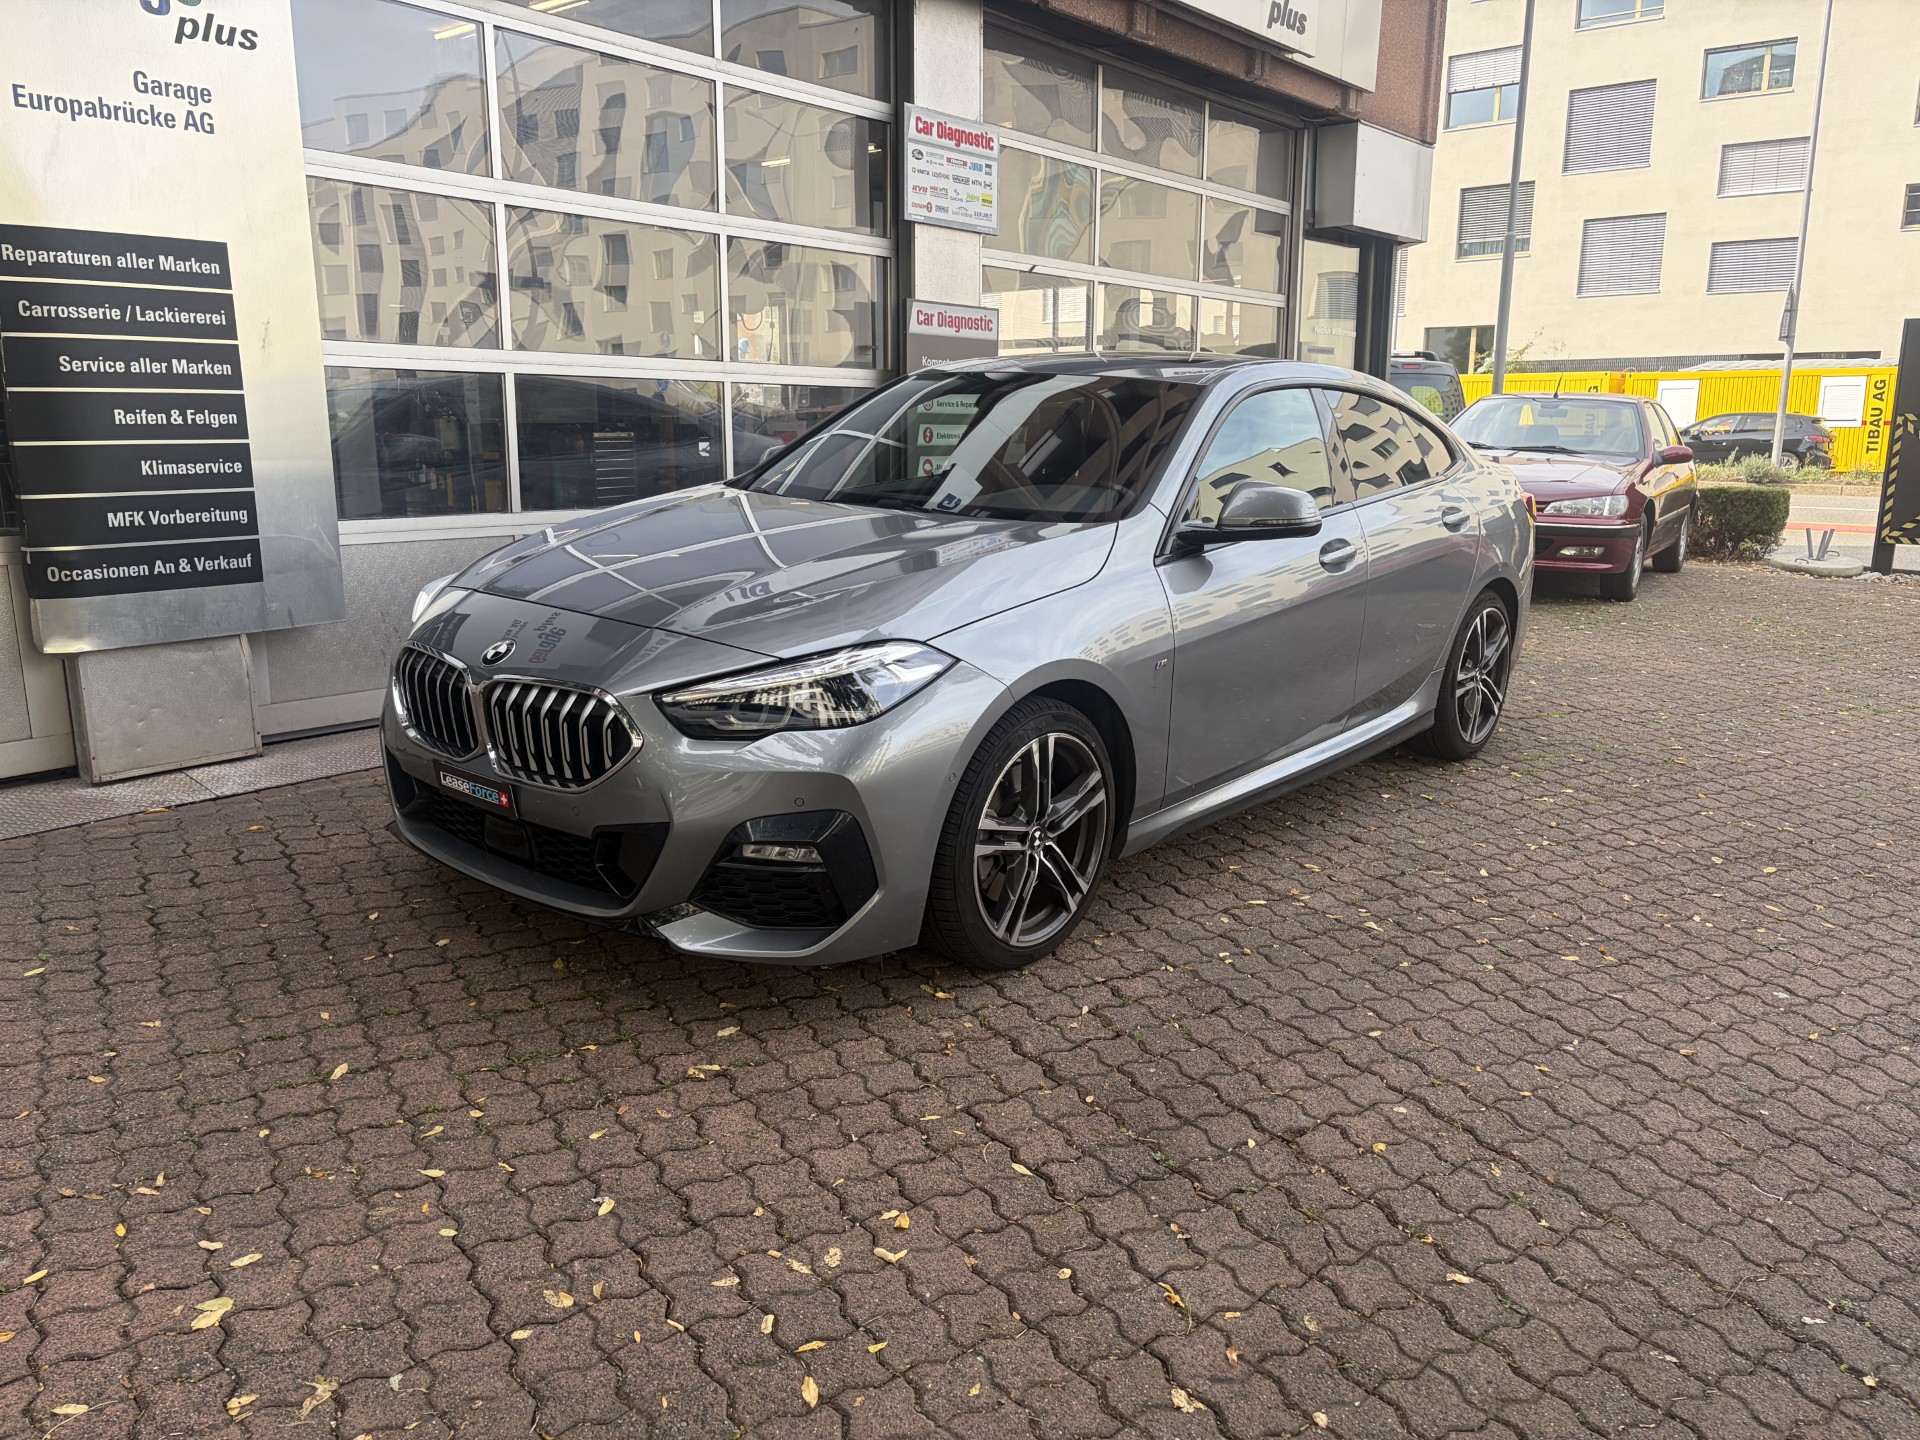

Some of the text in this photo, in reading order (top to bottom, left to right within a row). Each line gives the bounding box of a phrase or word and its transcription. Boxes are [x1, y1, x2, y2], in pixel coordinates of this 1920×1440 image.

[174, 13, 258, 51] plus
[1267, 0, 1307, 35] plus
[132, 70, 213, 107] Garage
[11, 83, 215, 135] Europabrücke AG
[915, 116, 994, 151] Car Diagnostic
[0, 243, 220, 275] Reparaturen aller Marken
[18, 299, 226, 326] Carrosserie / Lackiererei
[916, 309, 993, 333] Car Diagnostic
[58, 355, 232, 376] Service aller Marken
[114, 408, 238, 428] Reifen & Felgen
[937, 400, 955, 408] Service
[1866, 379, 1887, 454] TIBAU AG
[140, 458, 243, 476] Klimaservice
[107, 507, 248, 528] MFK Vorbereitung
[47, 553, 252, 582] Occasionen An & Verkauf
[440, 771, 499, 803] LeaseForce
